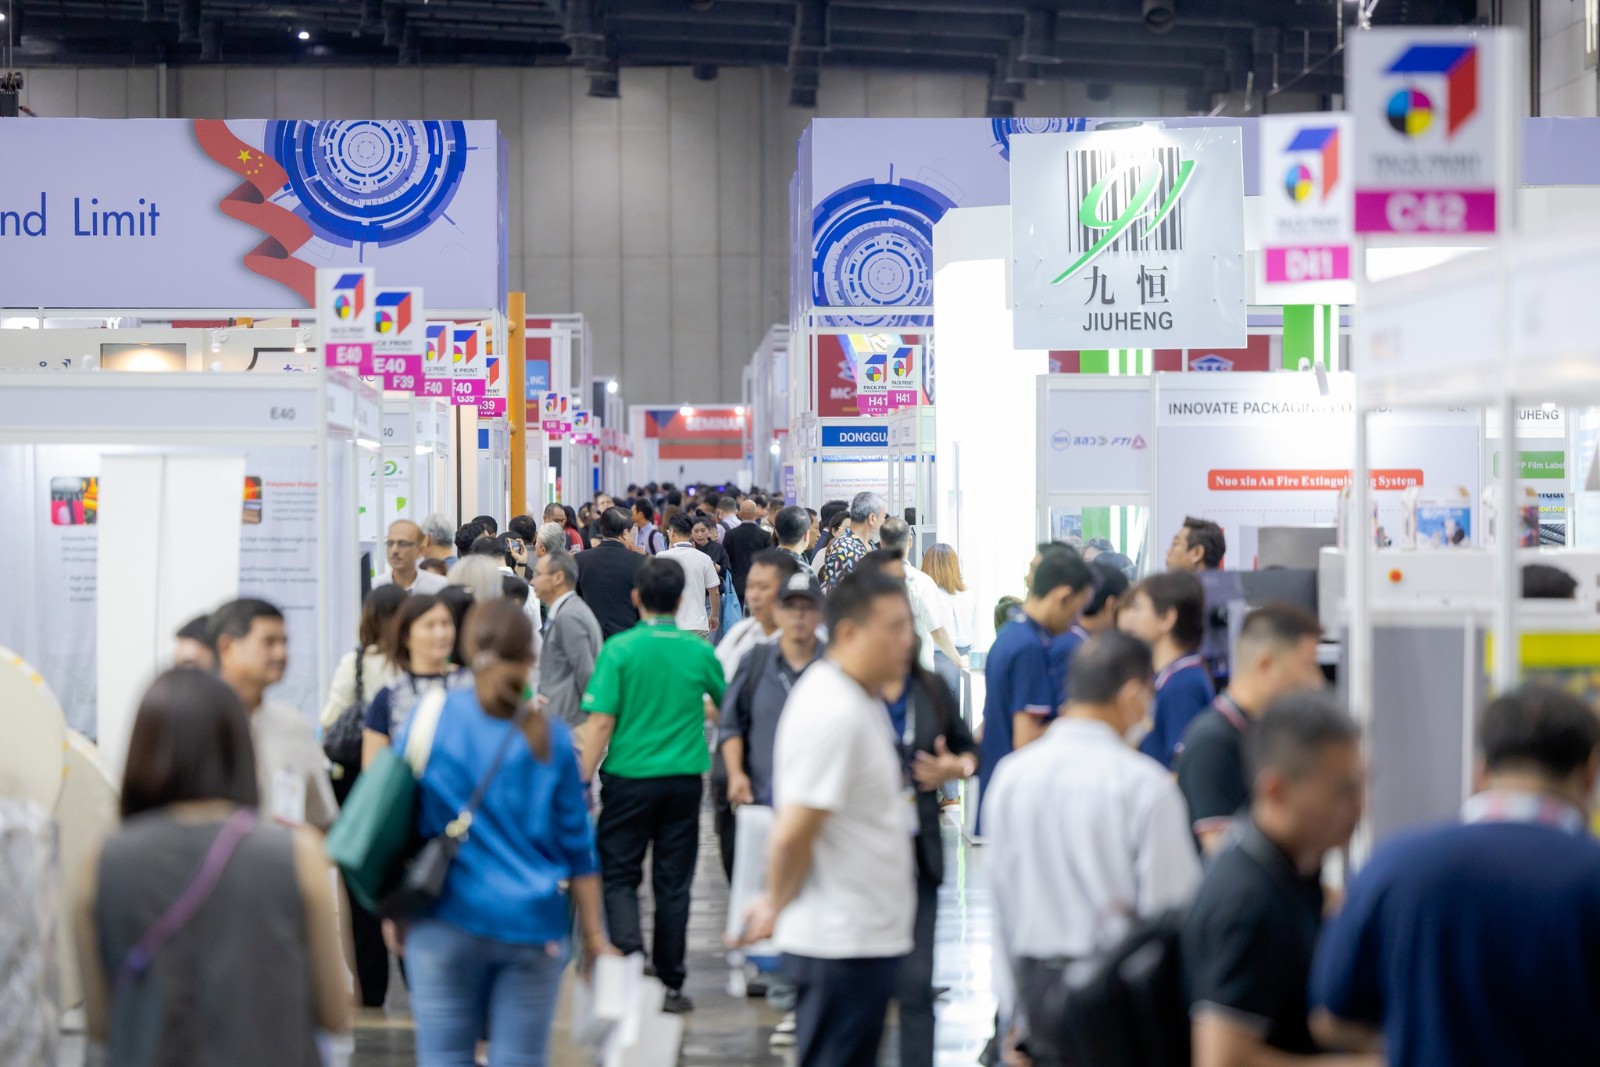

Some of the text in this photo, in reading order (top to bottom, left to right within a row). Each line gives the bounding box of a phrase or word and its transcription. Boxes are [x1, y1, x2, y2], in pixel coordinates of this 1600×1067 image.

[74, 197, 160, 236] Limit
[1083, 264, 1170, 306] 九恒
[1082, 311, 1174, 331] JIUHENG
[336, 346, 362, 364] E40
[373, 358, 406, 374] E40
[393, 375, 415, 388] F39
[424, 381, 443, 394] F40
[868, 397, 888, 406] H41
[895, 393, 910, 403] H41
[270, 407, 297, 420] E40
[1168, 402, 1238, 415] INNOVATE
[1515, 409, 1559, 420] IUHENG
[1528, 461, 1543, 469] Film
[1215, 475, 1238, 487] Nuo
[1240, 475, 1257, 487] xin
[1259, 475, 1275, 487] An
[1277, 475, 1299, 487] Fire
[1378, 475, 1417, 488] System
